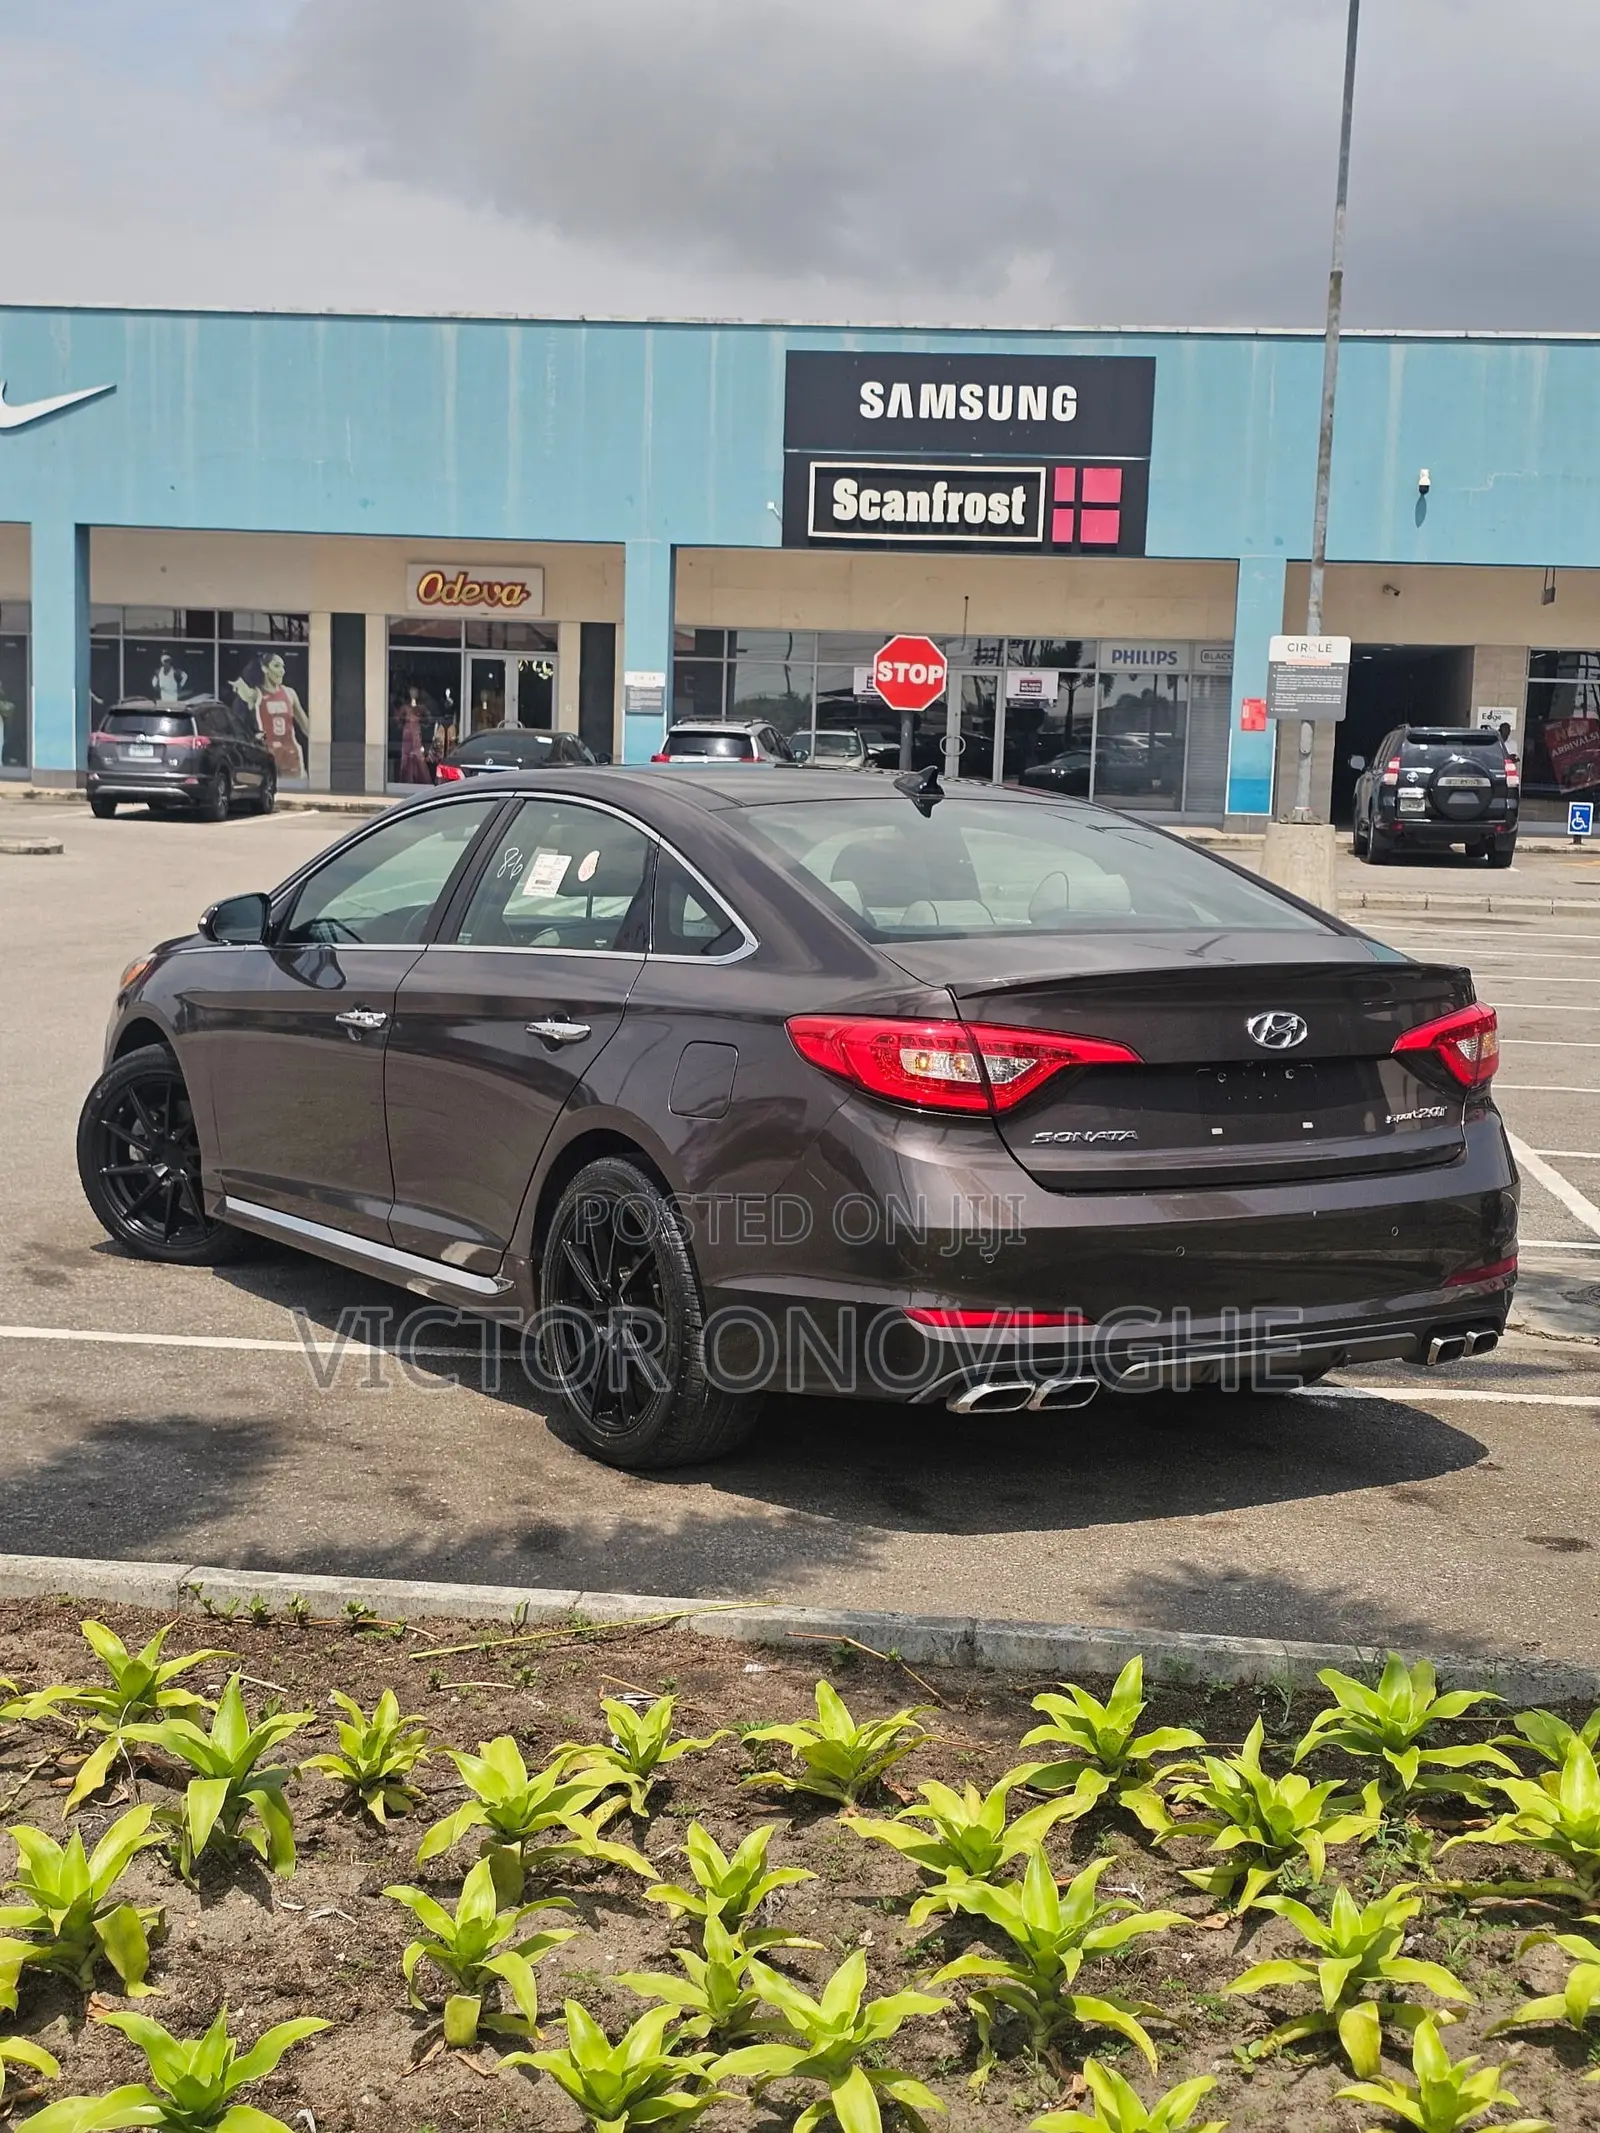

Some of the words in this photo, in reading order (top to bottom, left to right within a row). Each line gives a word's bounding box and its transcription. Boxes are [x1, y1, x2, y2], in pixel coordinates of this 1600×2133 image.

[859, 381, 1078, 422] SAMSUNG
[832, 477, 1027, 525] Scanfrost
[417, 570, 532, 608] Odeva
[1111, 649, 1178, 666] PHILIPS
[1287, 642, 1333, 653] CIRCLE
[877, 661, 944, 685] STOP
[272, 716, 286, 736] 9
[1481, 709, 1502, 723] Edge
[1031, 1130, 1139, 1144] SONATA
